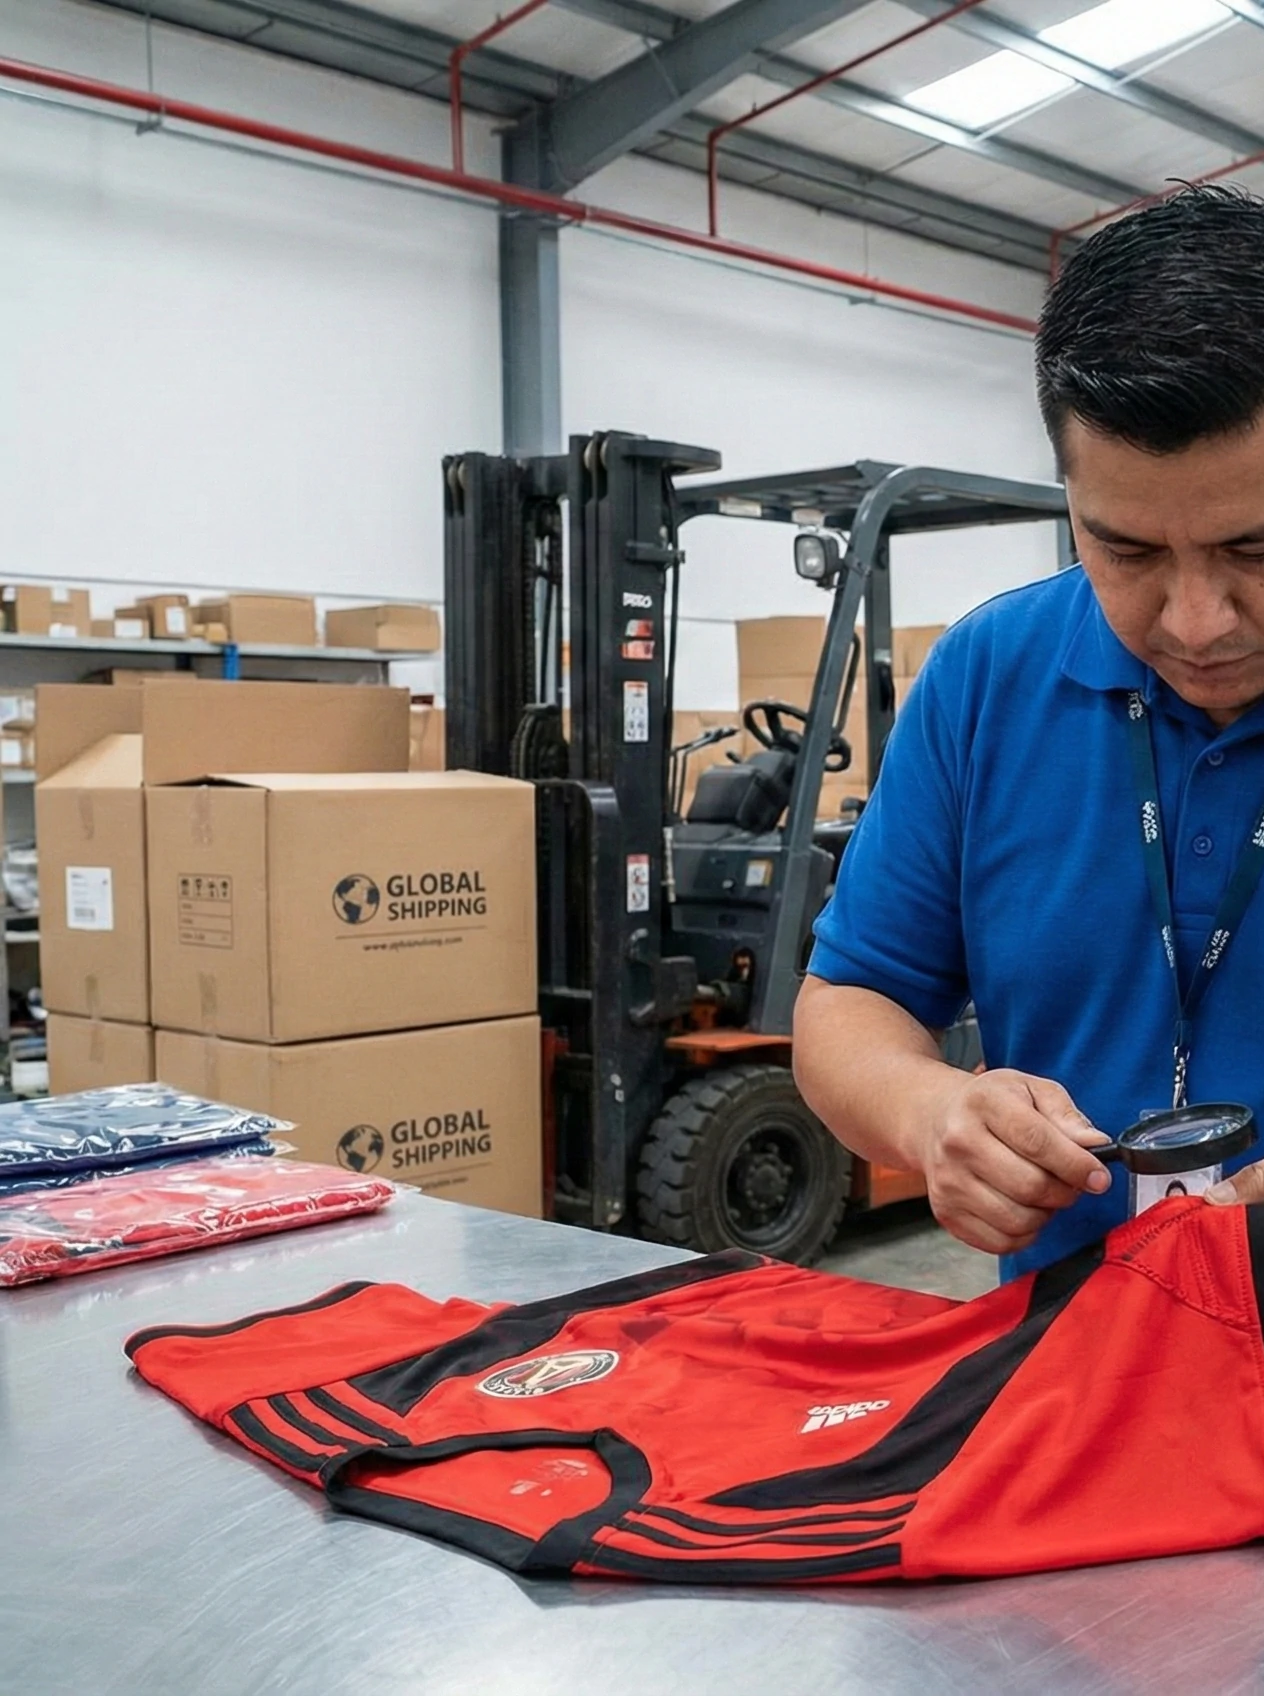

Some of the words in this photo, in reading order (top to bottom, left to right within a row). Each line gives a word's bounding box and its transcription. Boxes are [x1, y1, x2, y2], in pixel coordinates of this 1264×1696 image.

[386, 871, 486, 898] GLOBAL
[387, 897, 487, 921] SHIPPING
[390, 1109, 490, 1144] GLOBAL
[392, 1134, 492, 1169] SHIPPING
